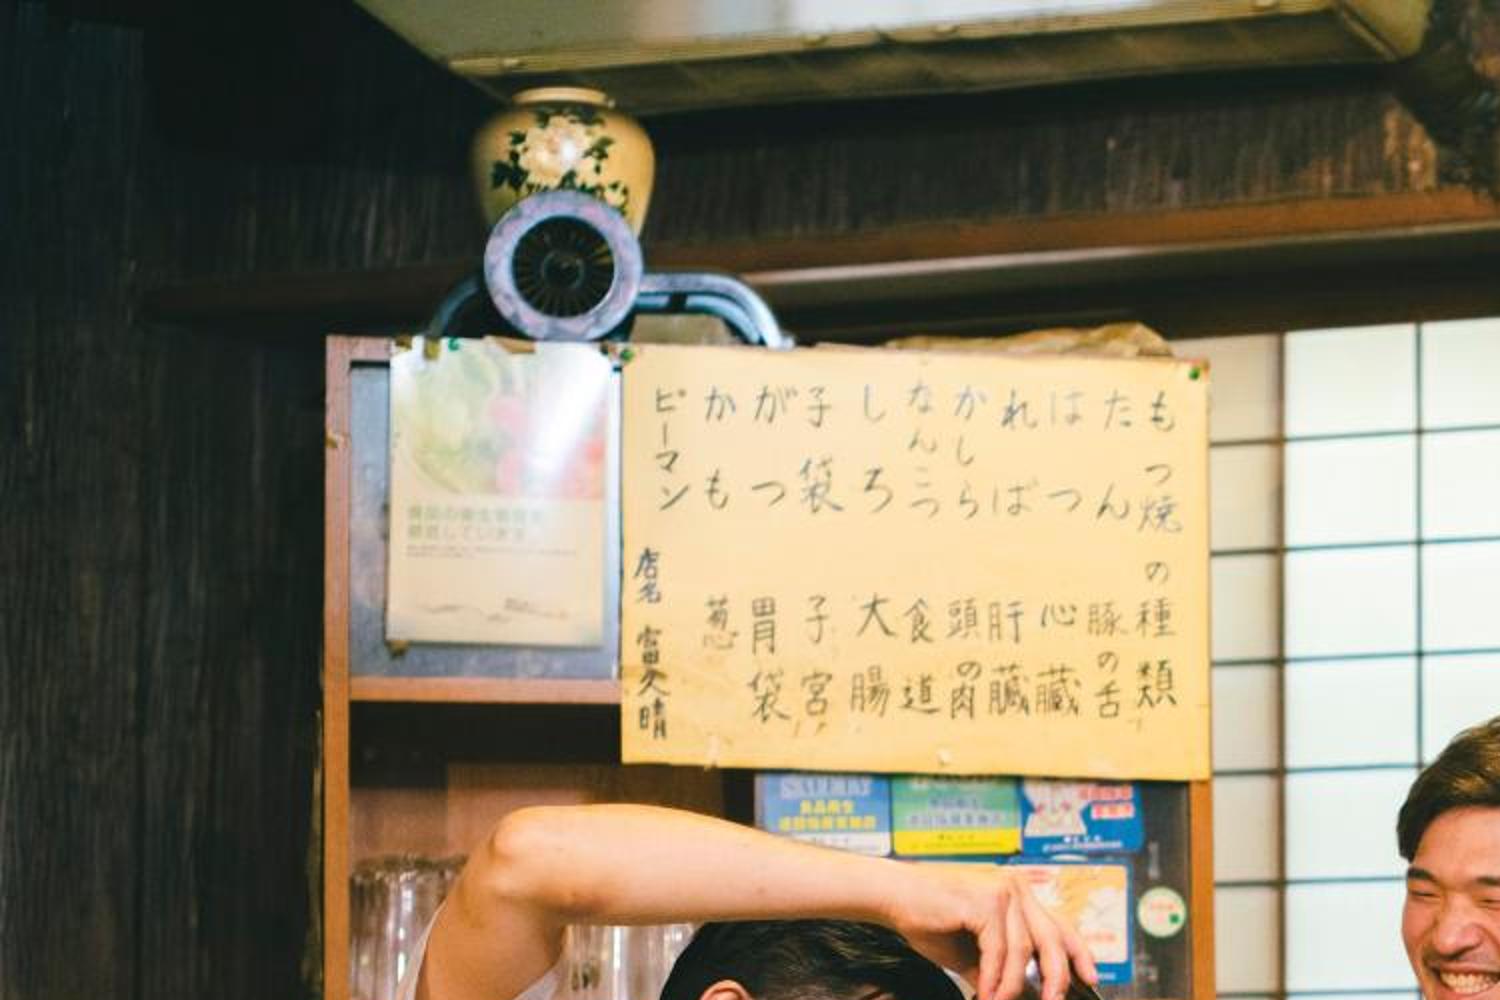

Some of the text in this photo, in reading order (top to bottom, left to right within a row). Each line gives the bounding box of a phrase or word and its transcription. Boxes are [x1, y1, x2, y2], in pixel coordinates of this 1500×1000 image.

[654, 388, 690, 511] ピーマン
[705, 387, 736, 510] かも
[993, 389, 1038, 516] れば
[1048, 392, 1083, 512] はつ
[1096, 390, 1132, 519] たん
[634, 547, 662, 603] 店名
[747, 385, 798, 724] がつ 胃袋
[947, 386, 986, 720] かしら 頭の肉
[801, 594, 833, 717] 子宮
[850, 593, 896, 718] 大腸
[899, 598, 941, 715] 食道
